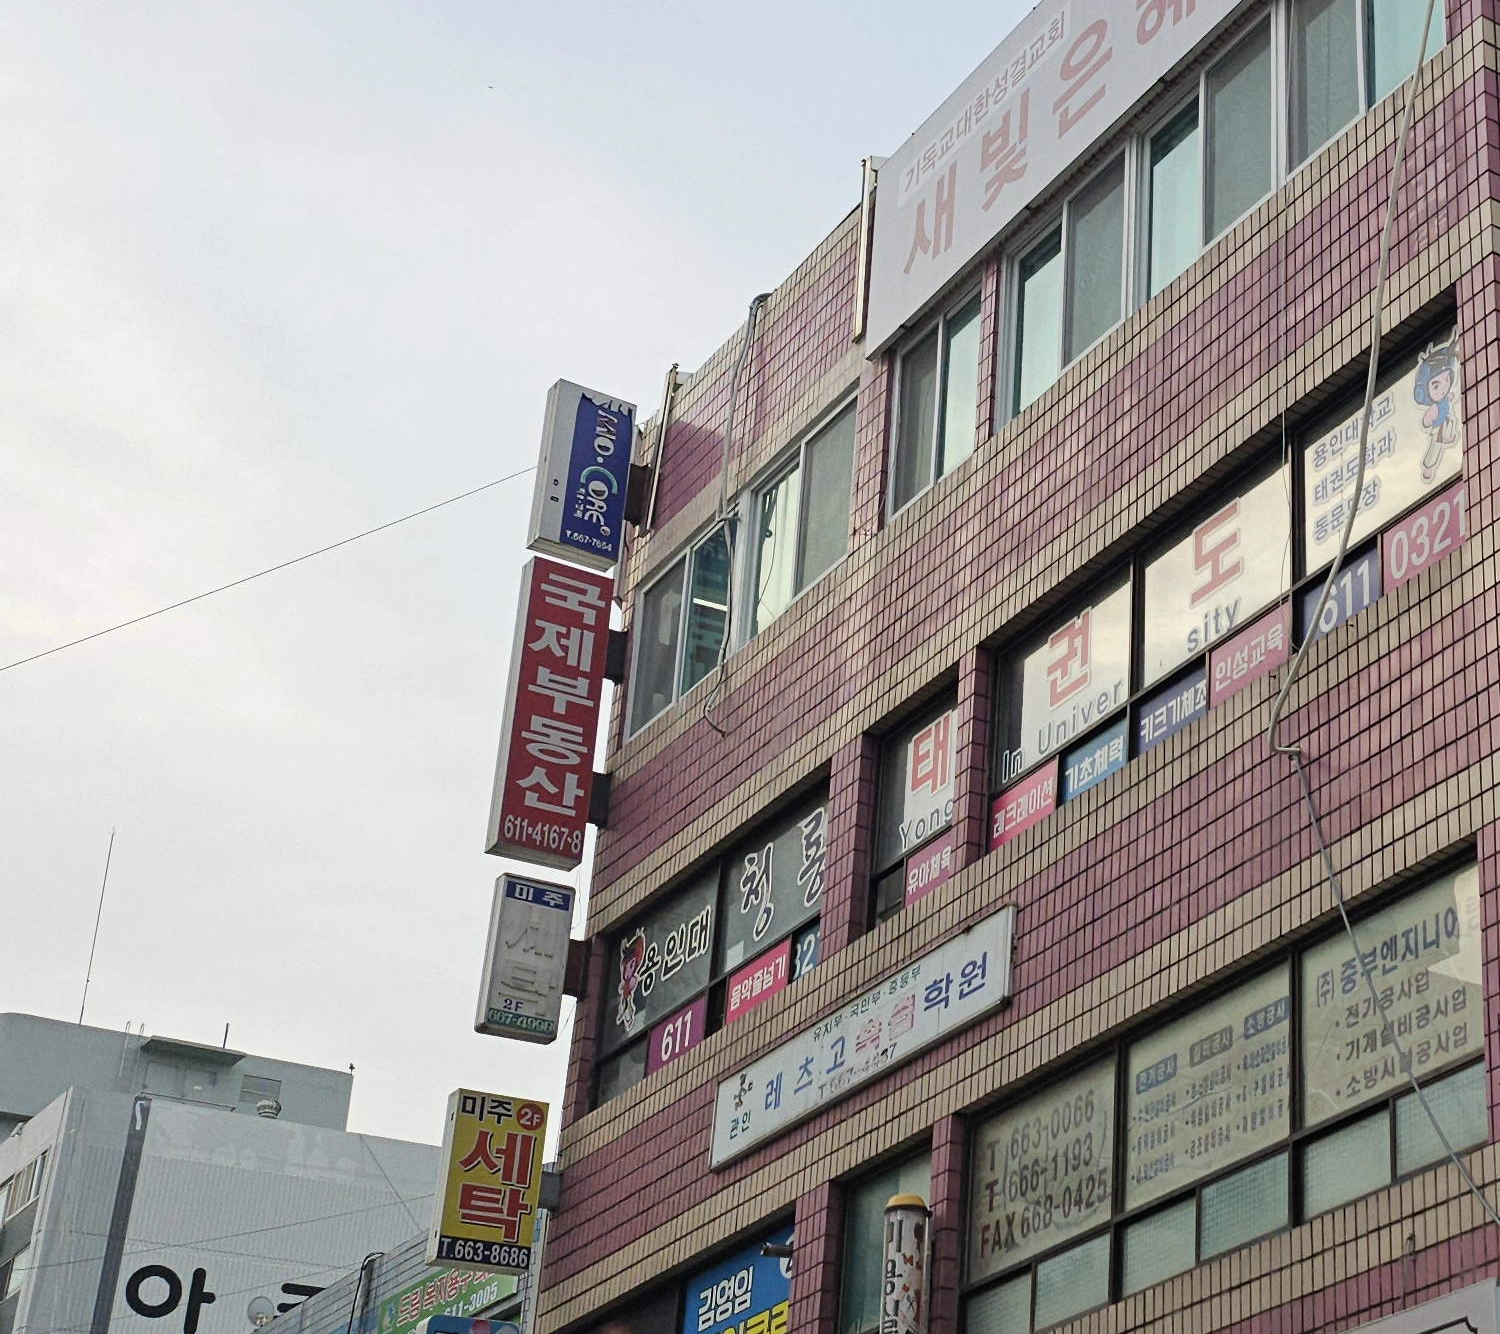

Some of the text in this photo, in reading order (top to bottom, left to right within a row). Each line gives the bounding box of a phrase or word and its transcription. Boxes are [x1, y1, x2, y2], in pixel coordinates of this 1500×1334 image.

[905, 10, 1067, 194] 기독교대한성결교회
[1317, 487, 1467, 635] 611 0321
[1214, 622, 1284, 692] 인성교육
[515, 571, 607, 818] 국제부동산
[1140, 678, 1206, 744] 키크기체조
[1065, 738, 1124, 794] 기초체력
[504, 814, 582, 855] 611-4167-8
[993, 776, 1053, 839] 레크레이션
[514, 883, 565, 908] 미주
[503, 998, 525, 1013] 2F
[729, 953, 787, 1013] 음악줄넘기
[923, 951, 988, 1012] 학원
[661, 1010, 692, 1062] 611
[461, 1094, 542, 1127] 미주 2F
[729, 1110, 752, 1140] 관인
[457, 1129, 537, 1244] 세탁
[440, 1237, 530, 1268] T.663-8686
[697, 1265, 754, 1334] 김영임
